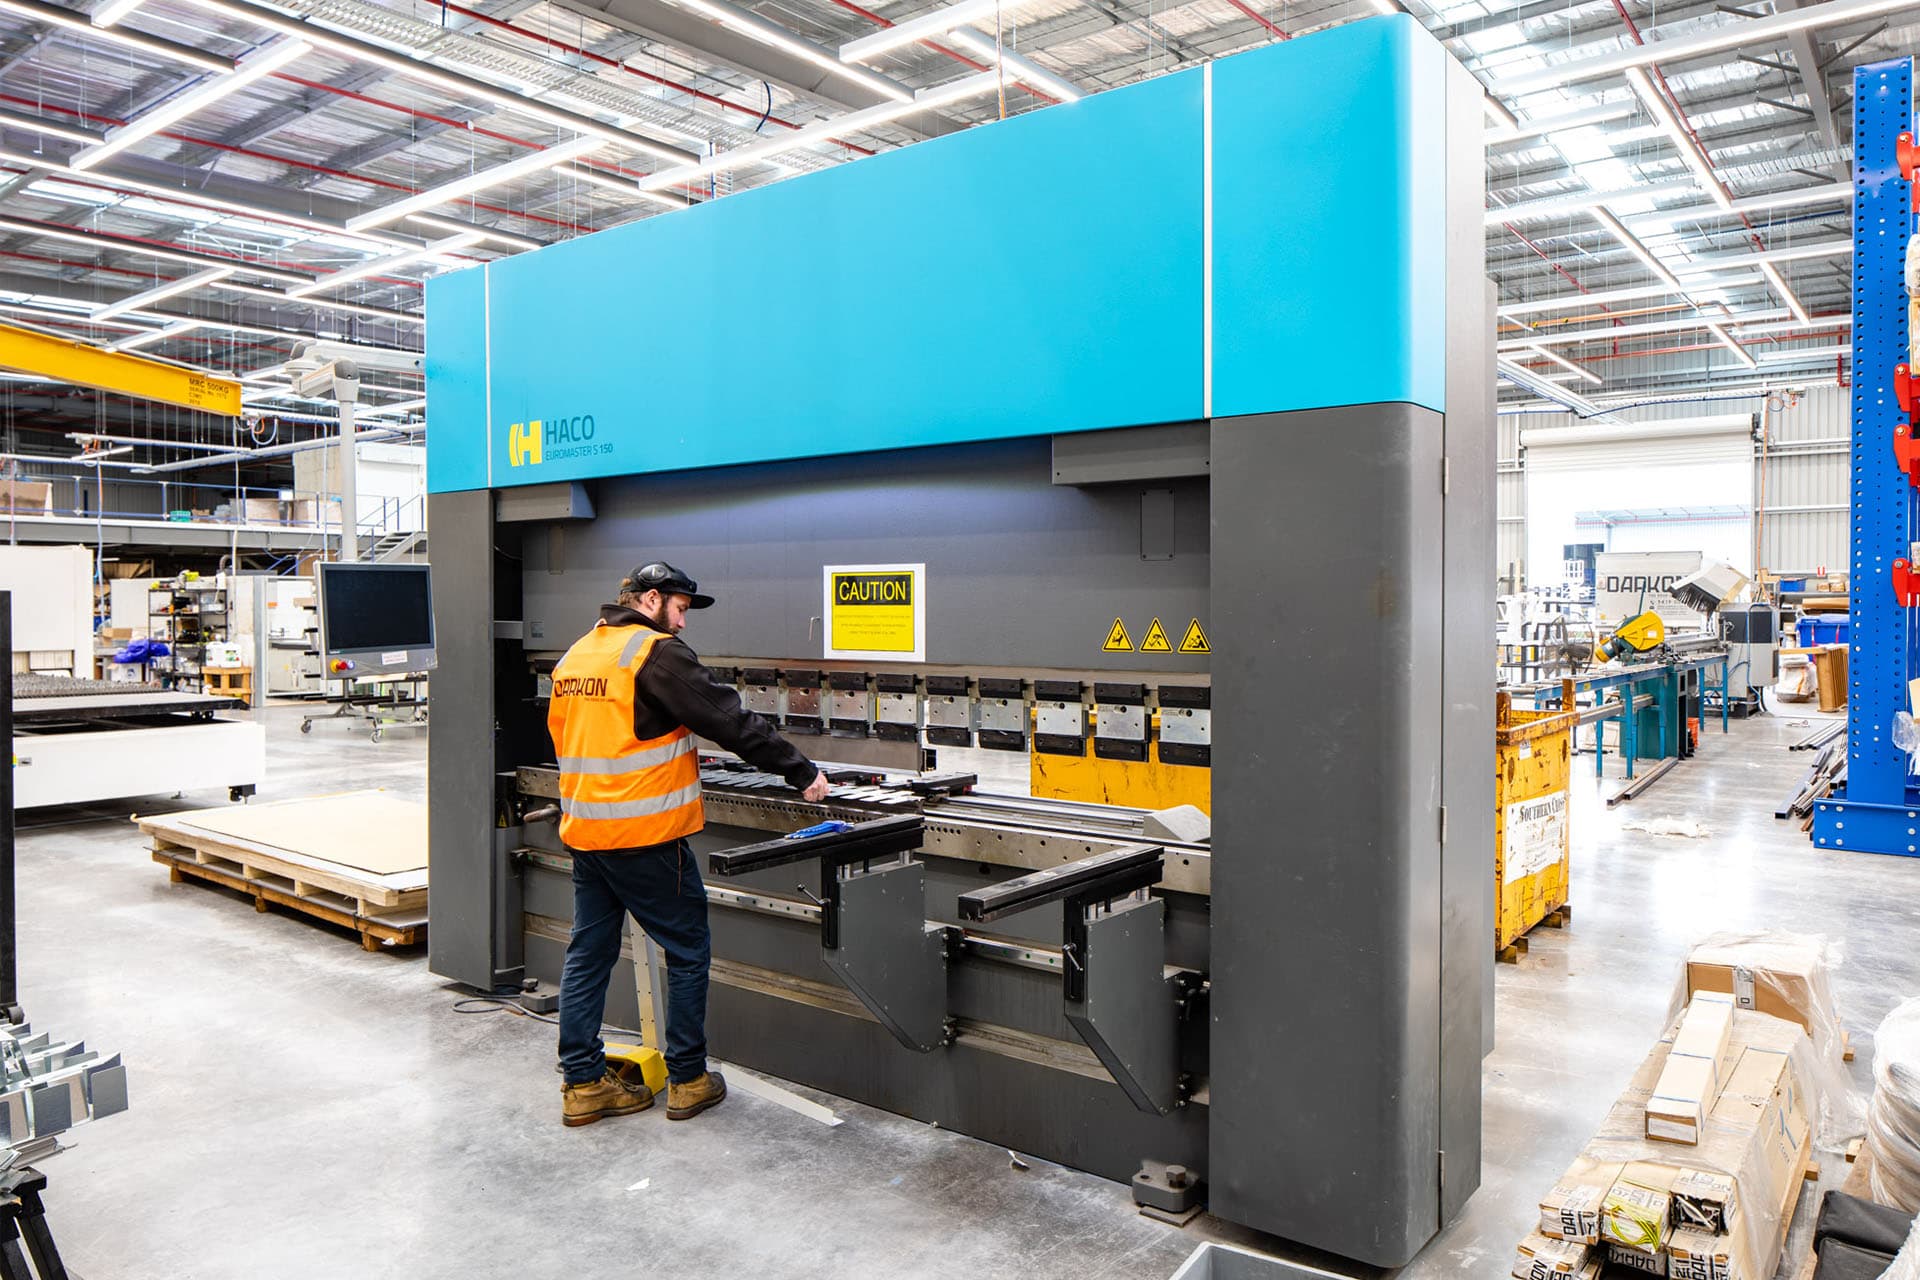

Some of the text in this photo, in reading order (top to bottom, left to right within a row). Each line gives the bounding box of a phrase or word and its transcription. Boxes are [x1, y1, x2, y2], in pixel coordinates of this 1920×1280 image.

[545, 414, 595, 446] HACO
[545, 446, 592, 461] EUROMASTER
[599, 443, 614, 455] 150
[839, 580, 906, 601] CAUTION
[1607, 576, 1688, 593] DARKO
[554, 677, 608, 698] DARKON
